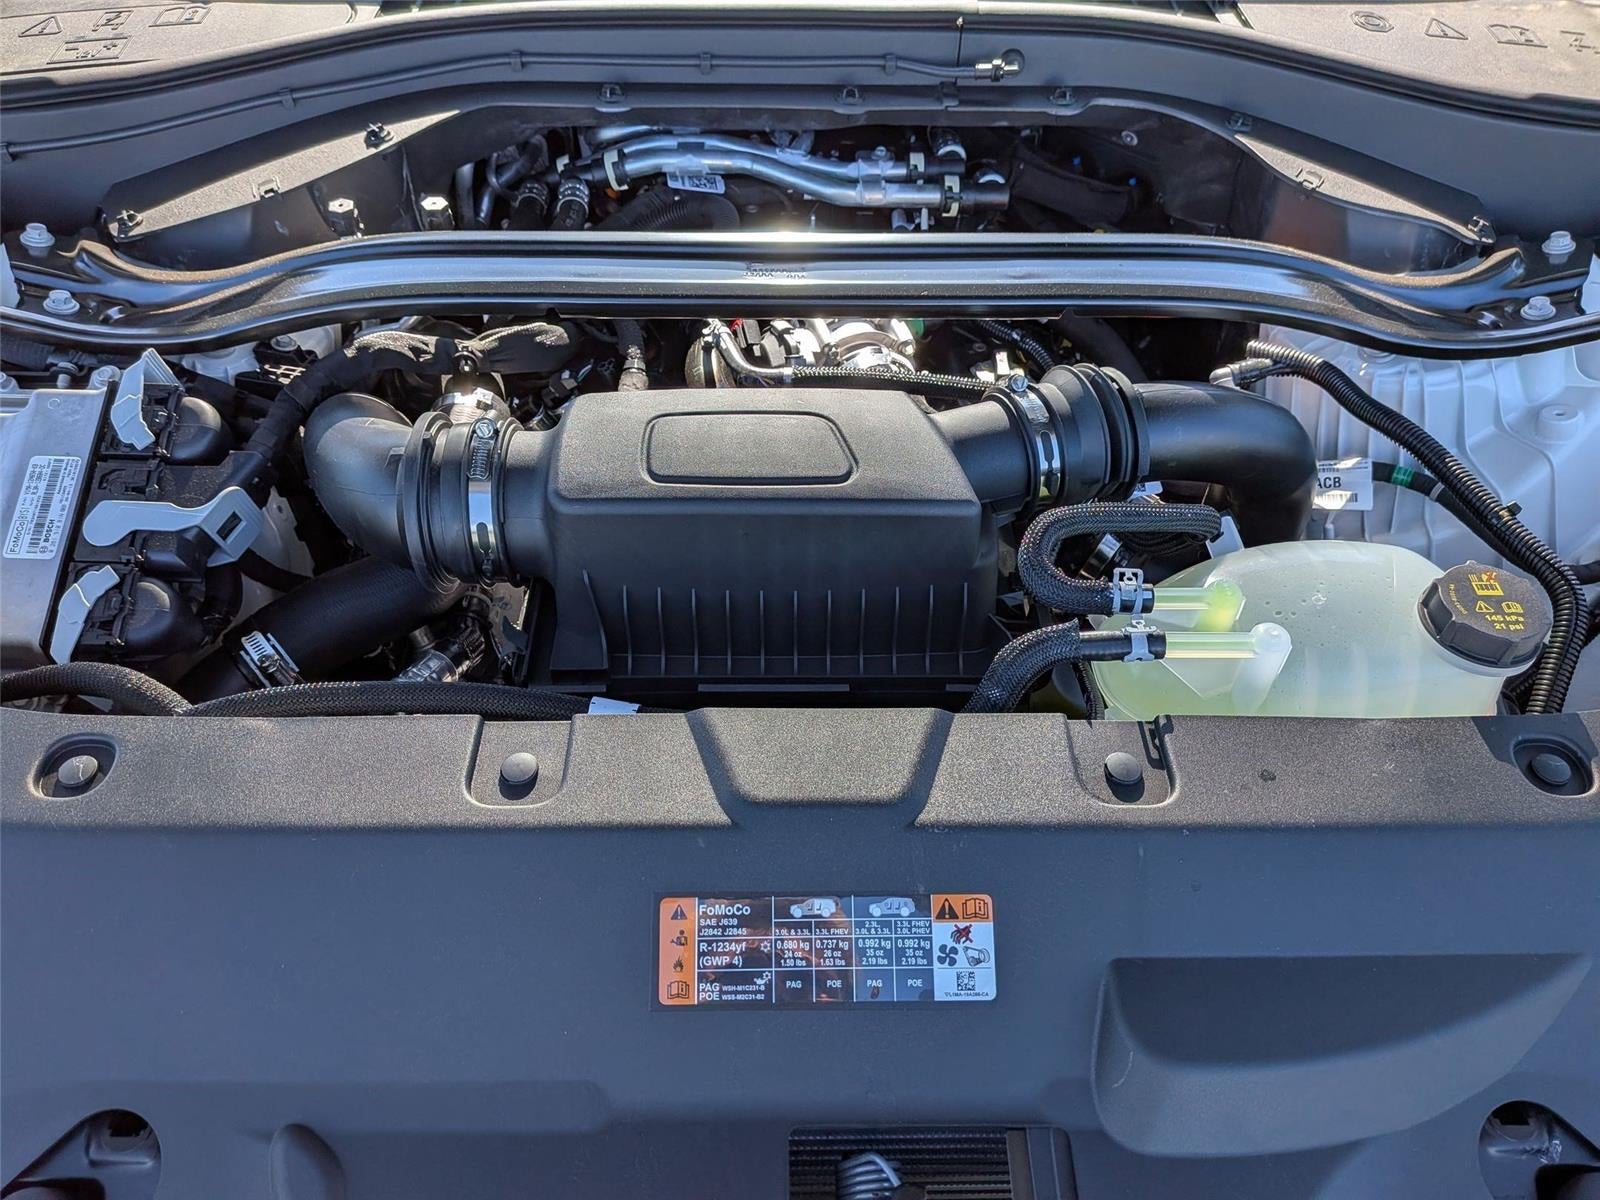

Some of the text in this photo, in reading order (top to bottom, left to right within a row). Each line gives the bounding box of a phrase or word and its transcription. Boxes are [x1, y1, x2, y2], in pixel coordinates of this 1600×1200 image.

[43, 519, 56, 542] BOSCH
[10, 522, 25, 552] FoMoCo
[699, 904, 751, 915] FoMoCo
[700, 941, 747, 954] R-1234yf
[776, 940, 810, 950] 0.680 kg
[816, 940, 849, 950] 0.737 kg
[858, 939, 891, 949] 0.992 kg
[897, 939, 930, 949] 0.992 kg
[699, 956, 742, 968] (GWP 4)
[699, 983, 720, 992] PAG
[699, 992, 720, 1000] POE
